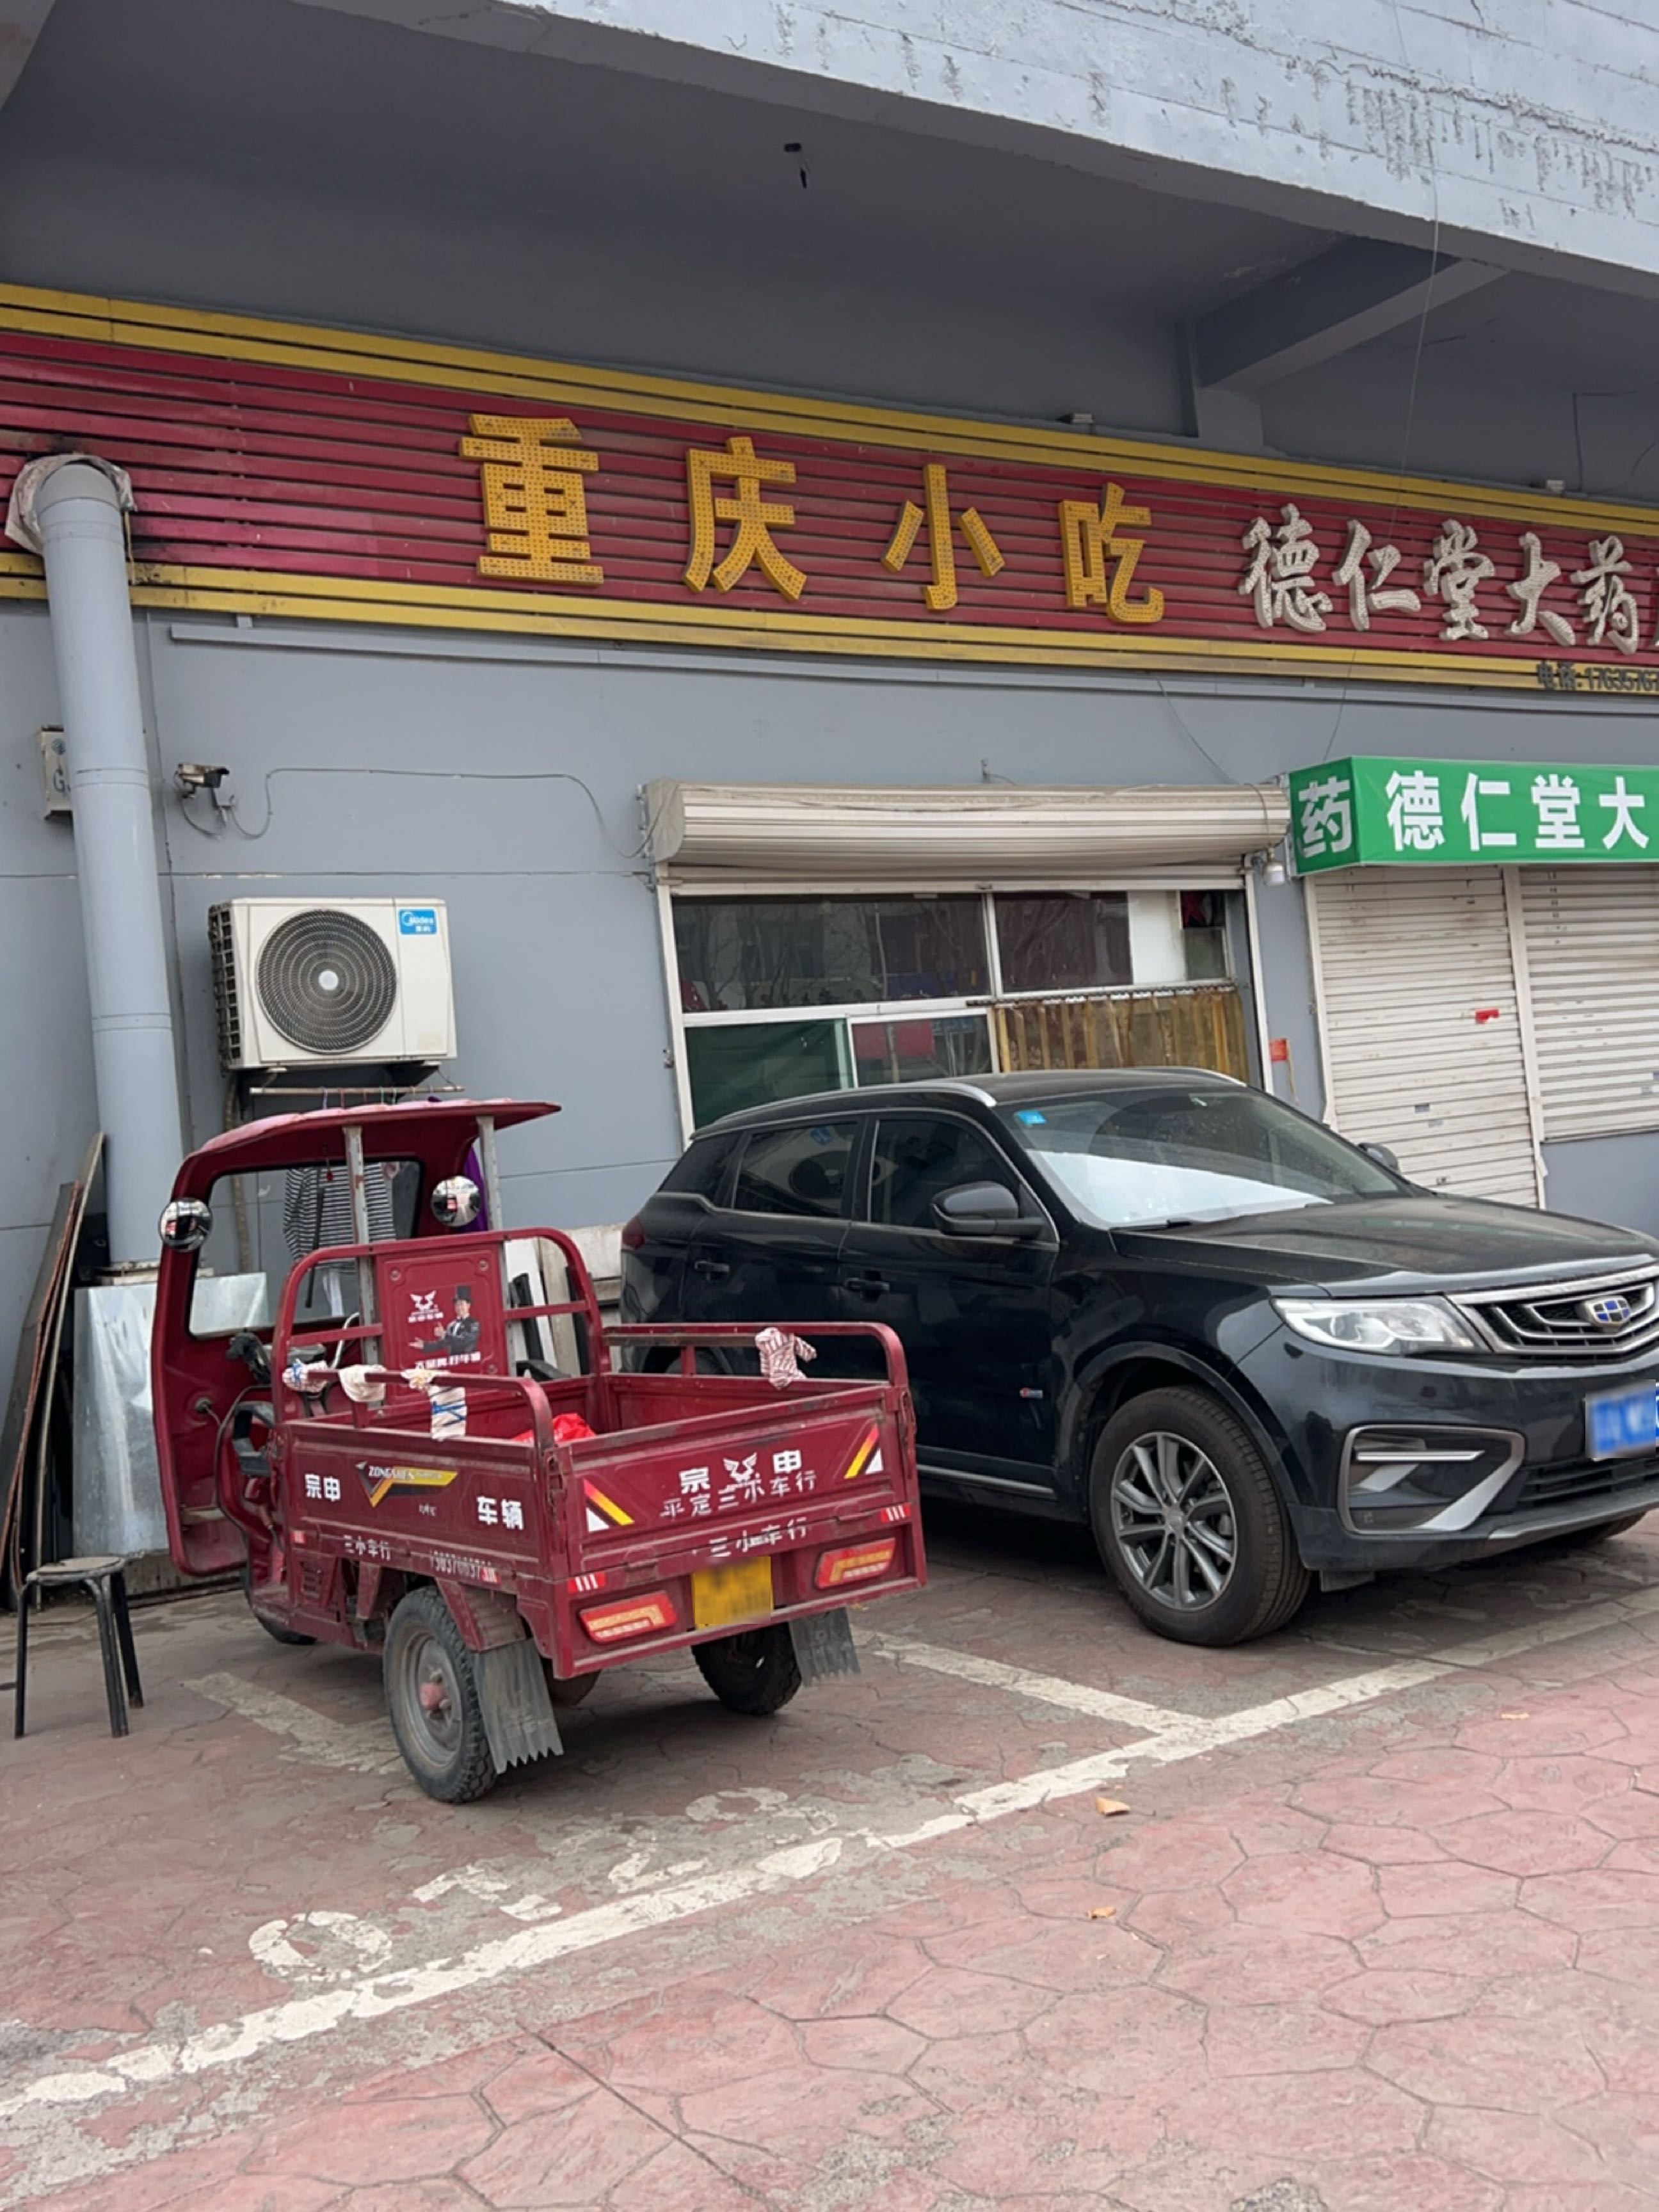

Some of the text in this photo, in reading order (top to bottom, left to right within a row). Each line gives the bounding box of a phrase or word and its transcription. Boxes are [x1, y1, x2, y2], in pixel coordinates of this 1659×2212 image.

[458, 413, 1164, 623] 重庆小吃
[1238, 502, 1659, 655] 德仁堂大药
[1298, 776, 1353, 858] 药
[1385, 770, 1649, 851] 德仁堂大
